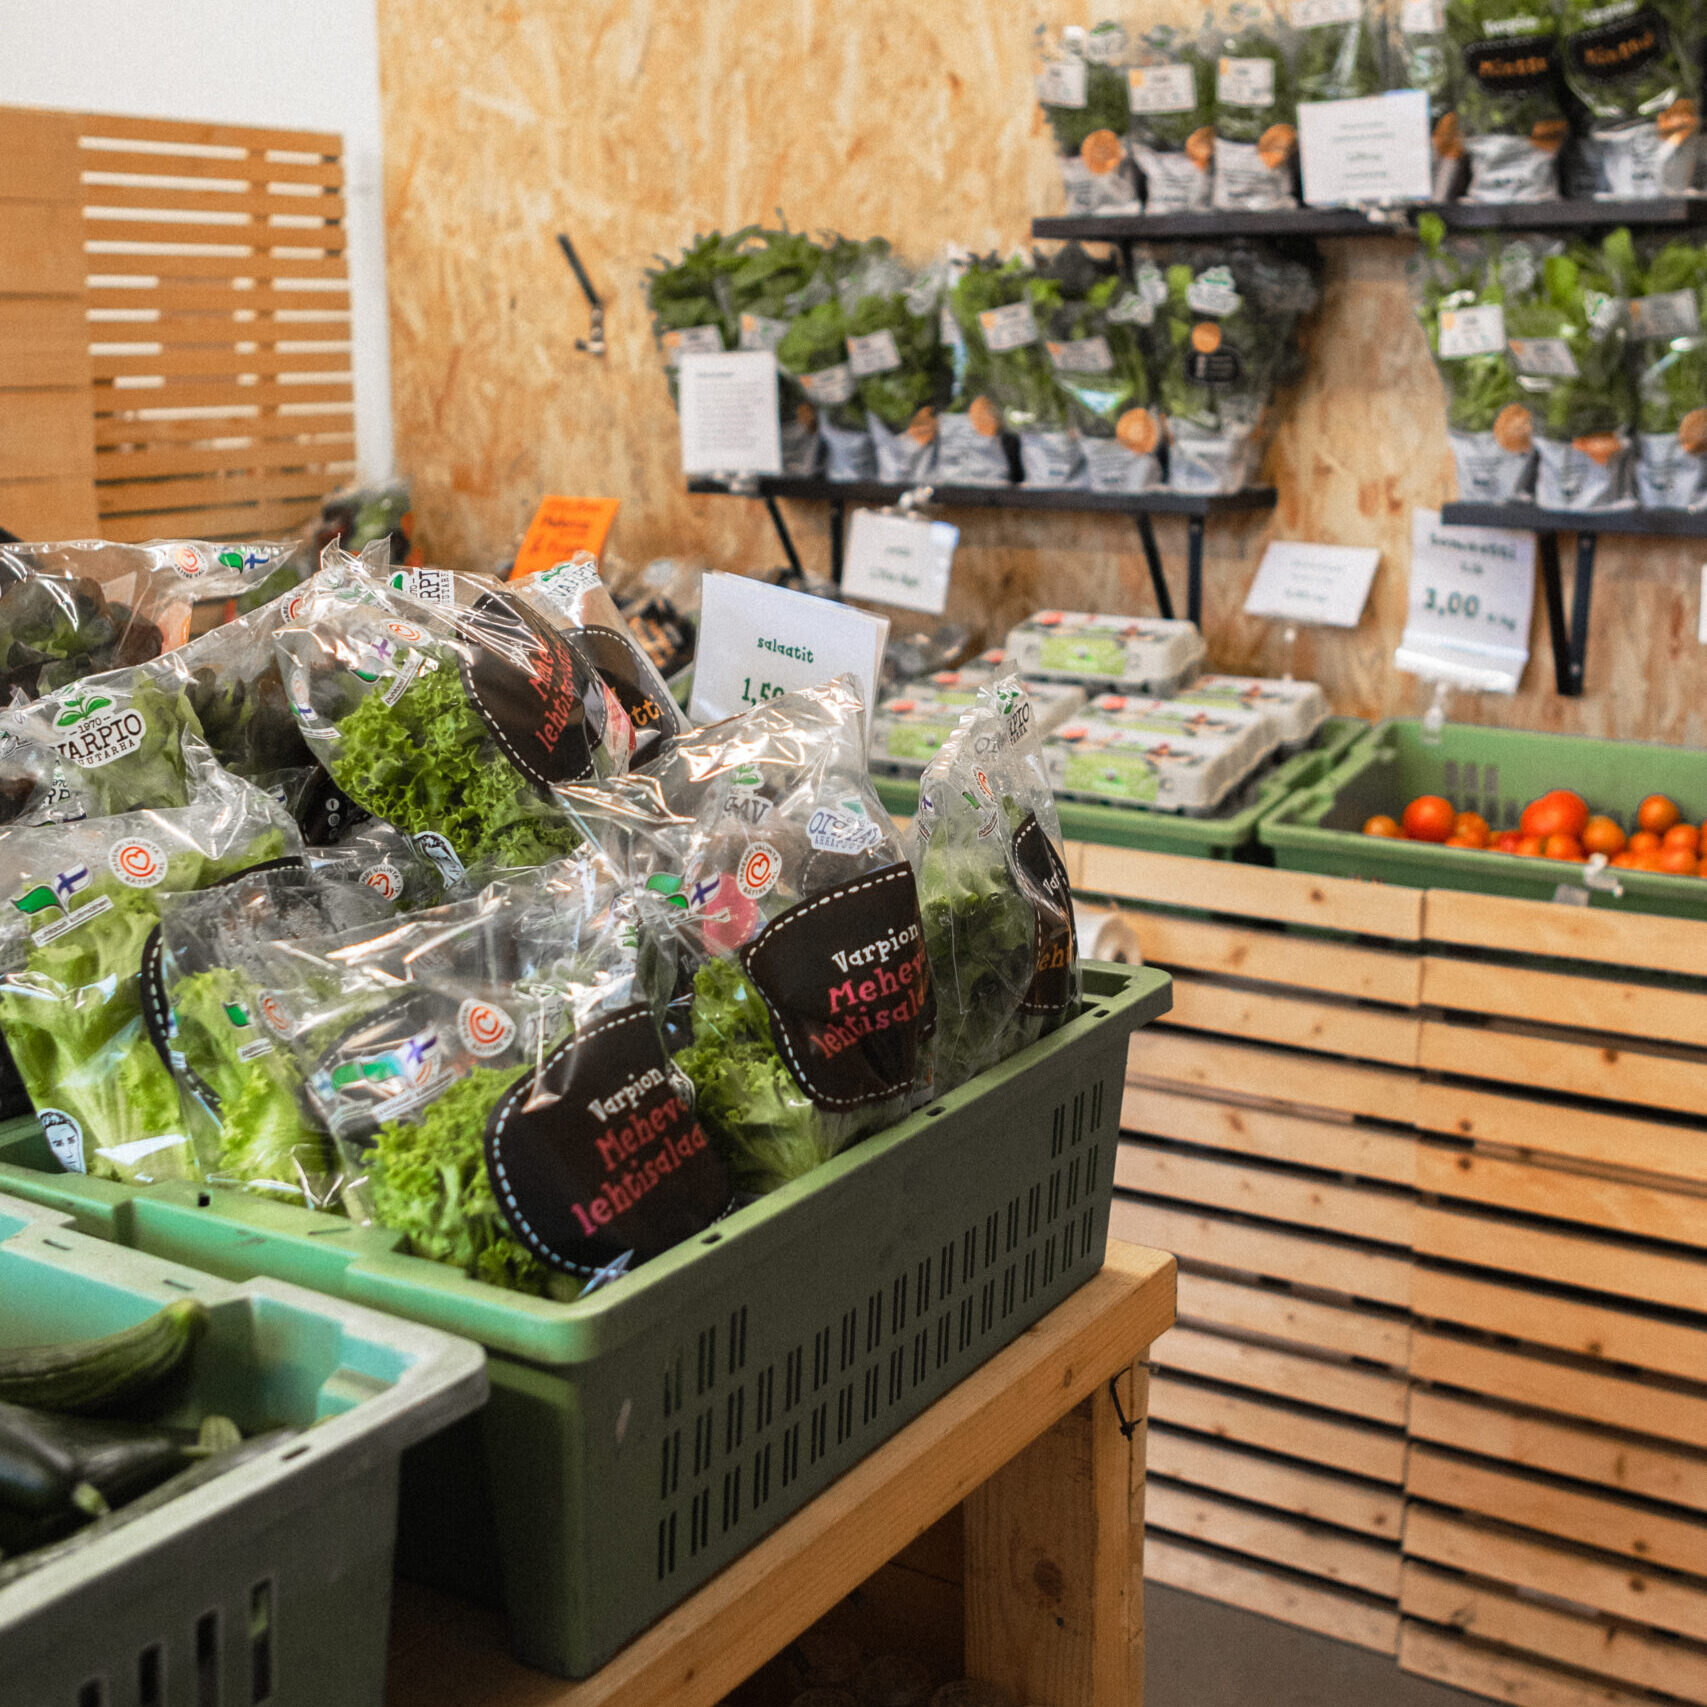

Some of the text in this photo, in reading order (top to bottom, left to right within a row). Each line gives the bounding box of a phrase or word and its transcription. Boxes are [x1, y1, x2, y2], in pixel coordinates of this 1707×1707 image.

[757, 636, 814, 664] salaatit
[76, 738, 136, 766] UUTARHA
[832, 923, 919, 974] Varpion
[587, 1067, 665, 1122] Varpion
